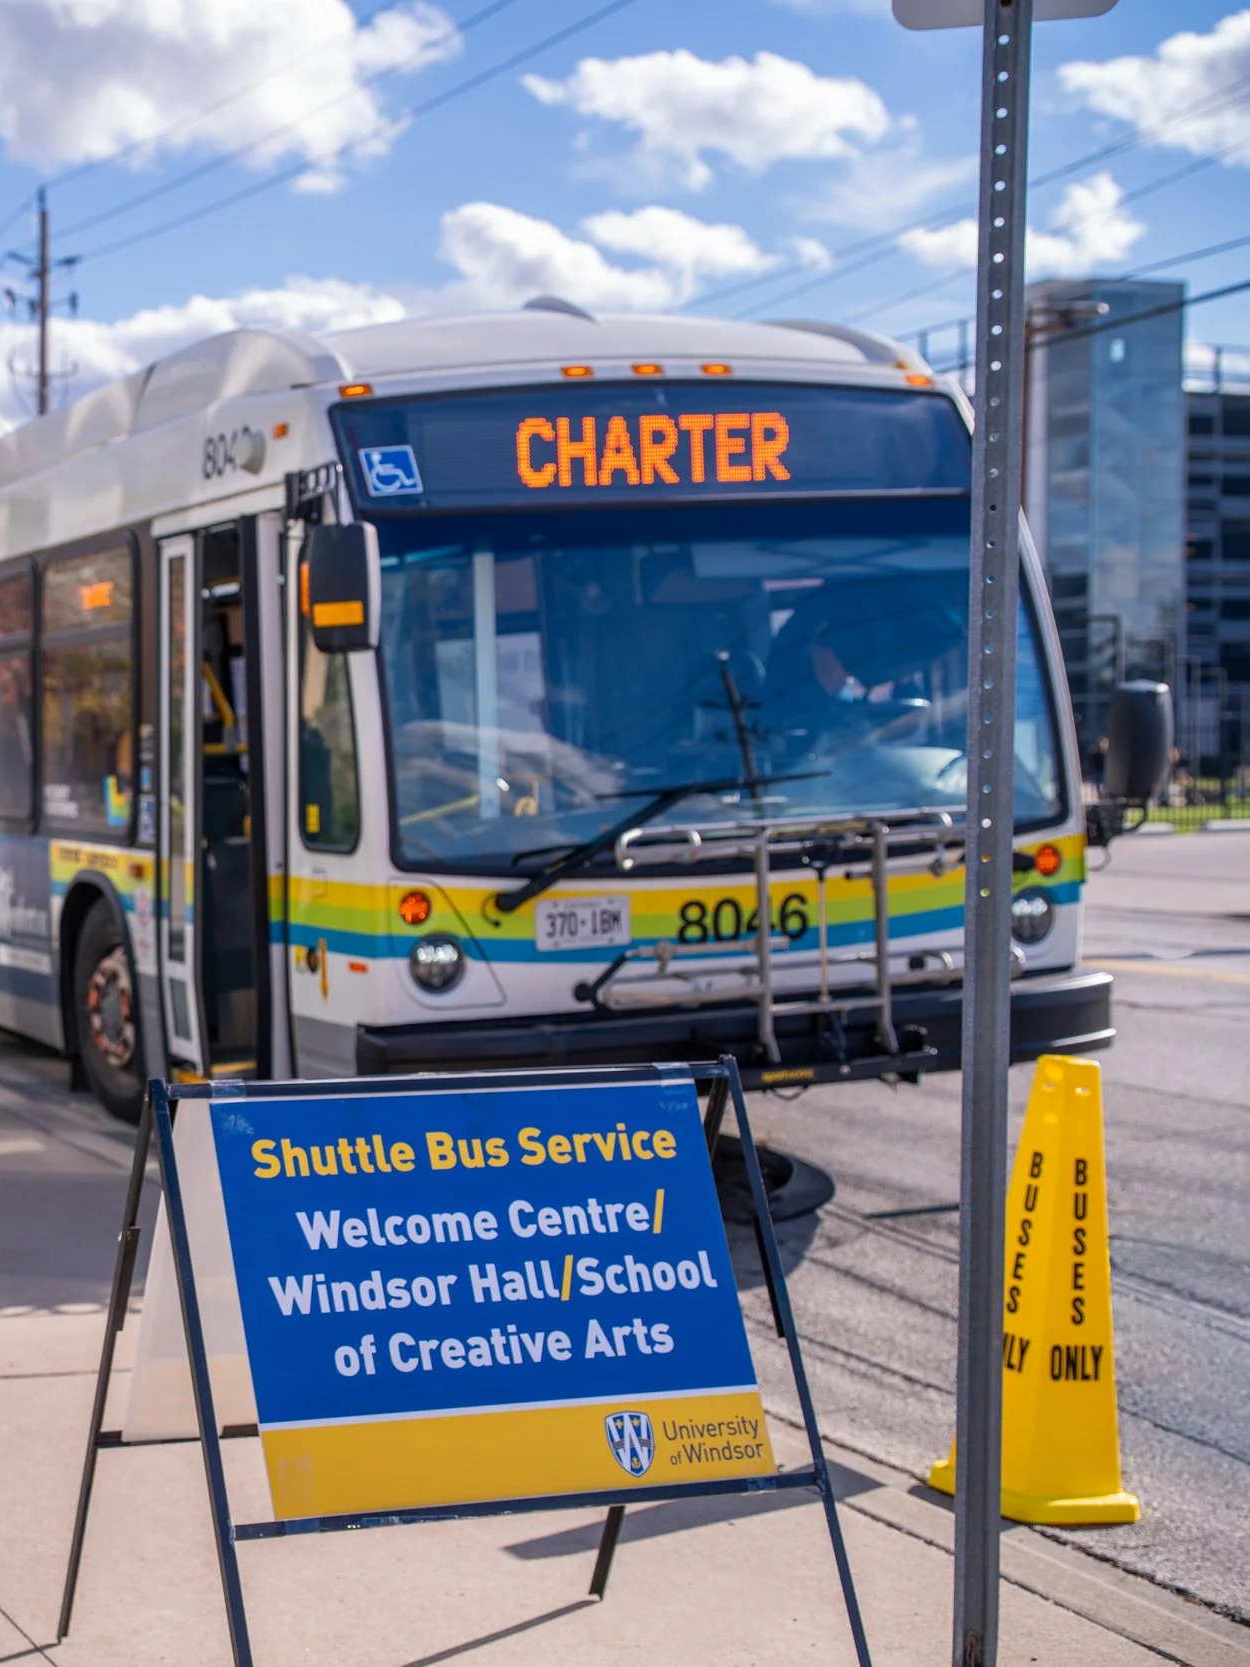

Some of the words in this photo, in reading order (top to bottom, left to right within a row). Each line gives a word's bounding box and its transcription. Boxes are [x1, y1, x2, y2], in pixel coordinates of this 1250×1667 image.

[516, 412, 790, 488] CHARTER
[676, 894, 809, 944] 8046
[251, 1135, 415, 1178] Shuttle
[426, 1131, 510, 1170] Bus
[519, 1122, 677, 1166] Service
[296, 1208, 498, 1250] Welcome
[509, 1189, 665, 1238] Centre/
[1006, 1151, 1044, 1314] BUSES
[1070, 1158, 1088, 1326] BUSES
[268, 1271, 458, 1316] Windsor
[470, 1250, 718, 1302] Hall/School
[335, 1334, 377, 1377] of
[389, 1324, 572, 1373] Creative
[586, 1318, 674, 1359] Arts
[1002, 1332, 1030, 1374] LY
[1050, 1345, 1104, 1382] ONLY
[662, 1414, 760, 1441] University
[669, 1451, 683, 1466] of
[682, 1440, 764, 1464] Windsor
